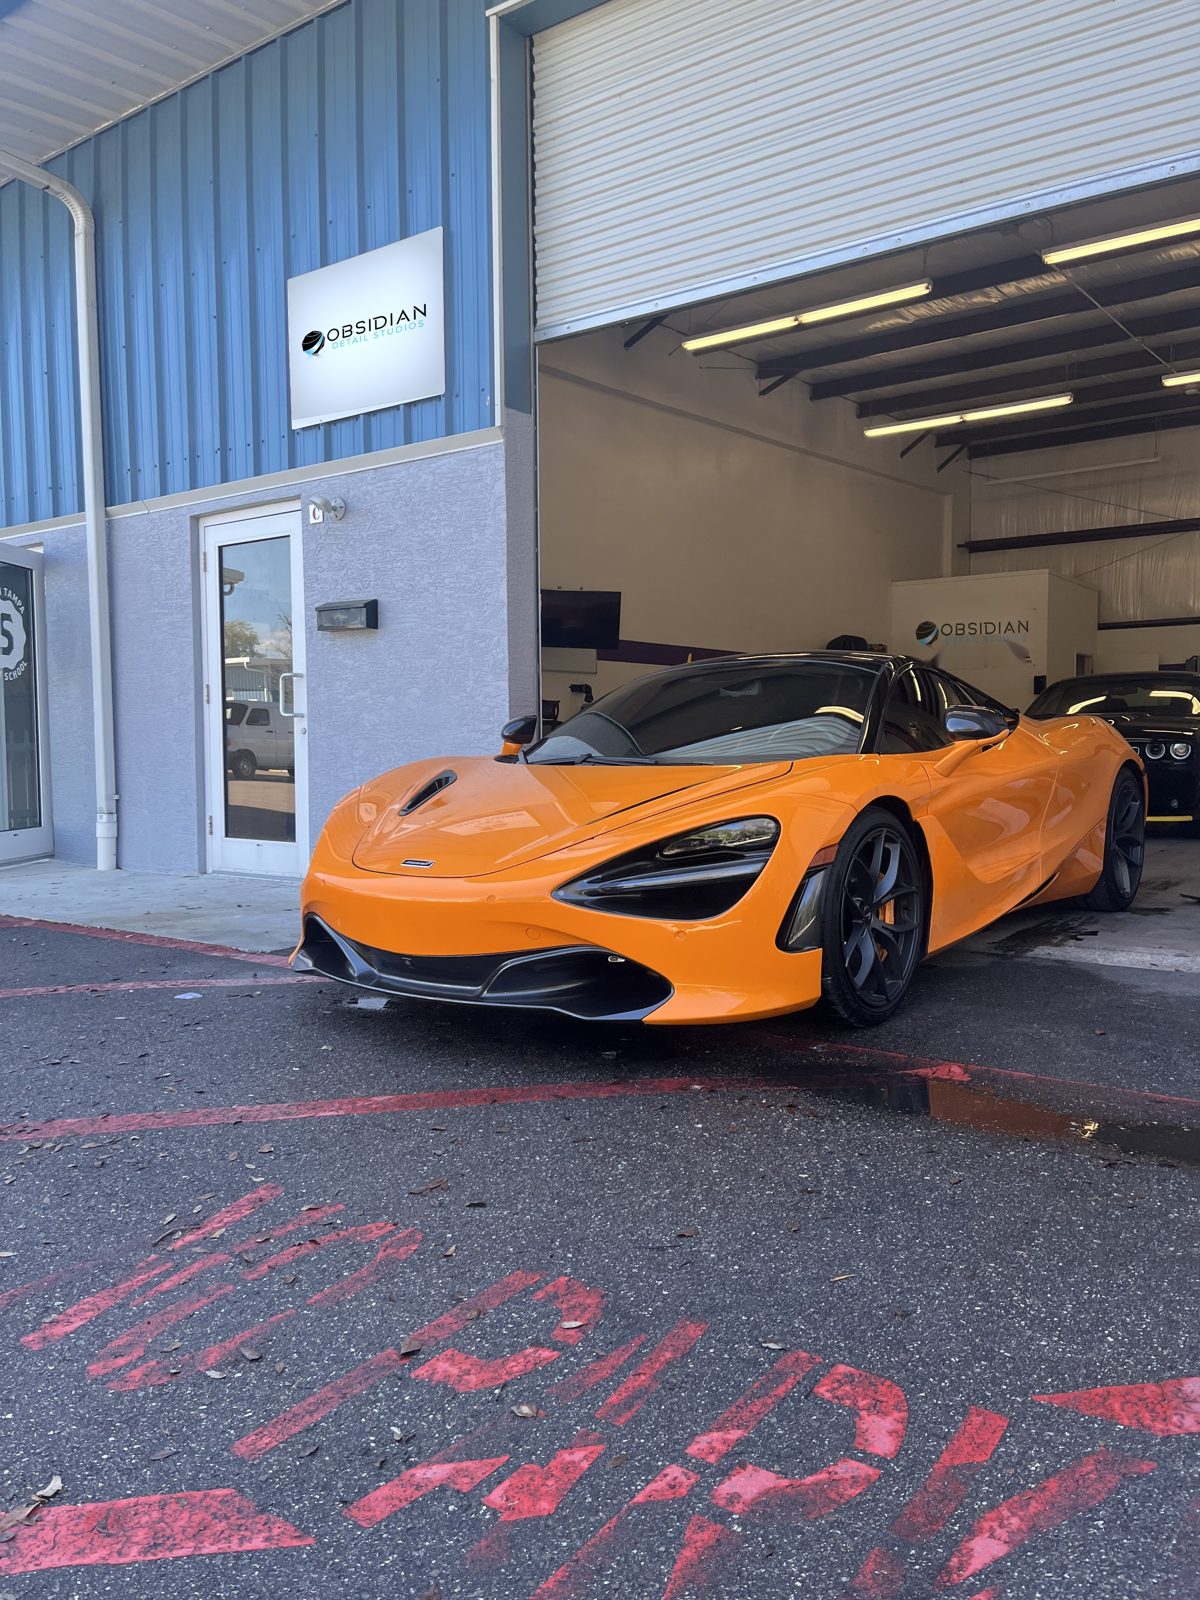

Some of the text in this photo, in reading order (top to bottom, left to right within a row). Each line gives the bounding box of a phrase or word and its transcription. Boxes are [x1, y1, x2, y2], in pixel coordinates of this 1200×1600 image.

[327, 303, 427, 342] OBSIDIAN
[331, 319, 425, 350] DETAIL STUDIOS
[3, 587, 25, 614] TAMPA
[940, 620, 1029, 636] OBSIDIAN
[4, 660, 28, 681] SCHOOL
